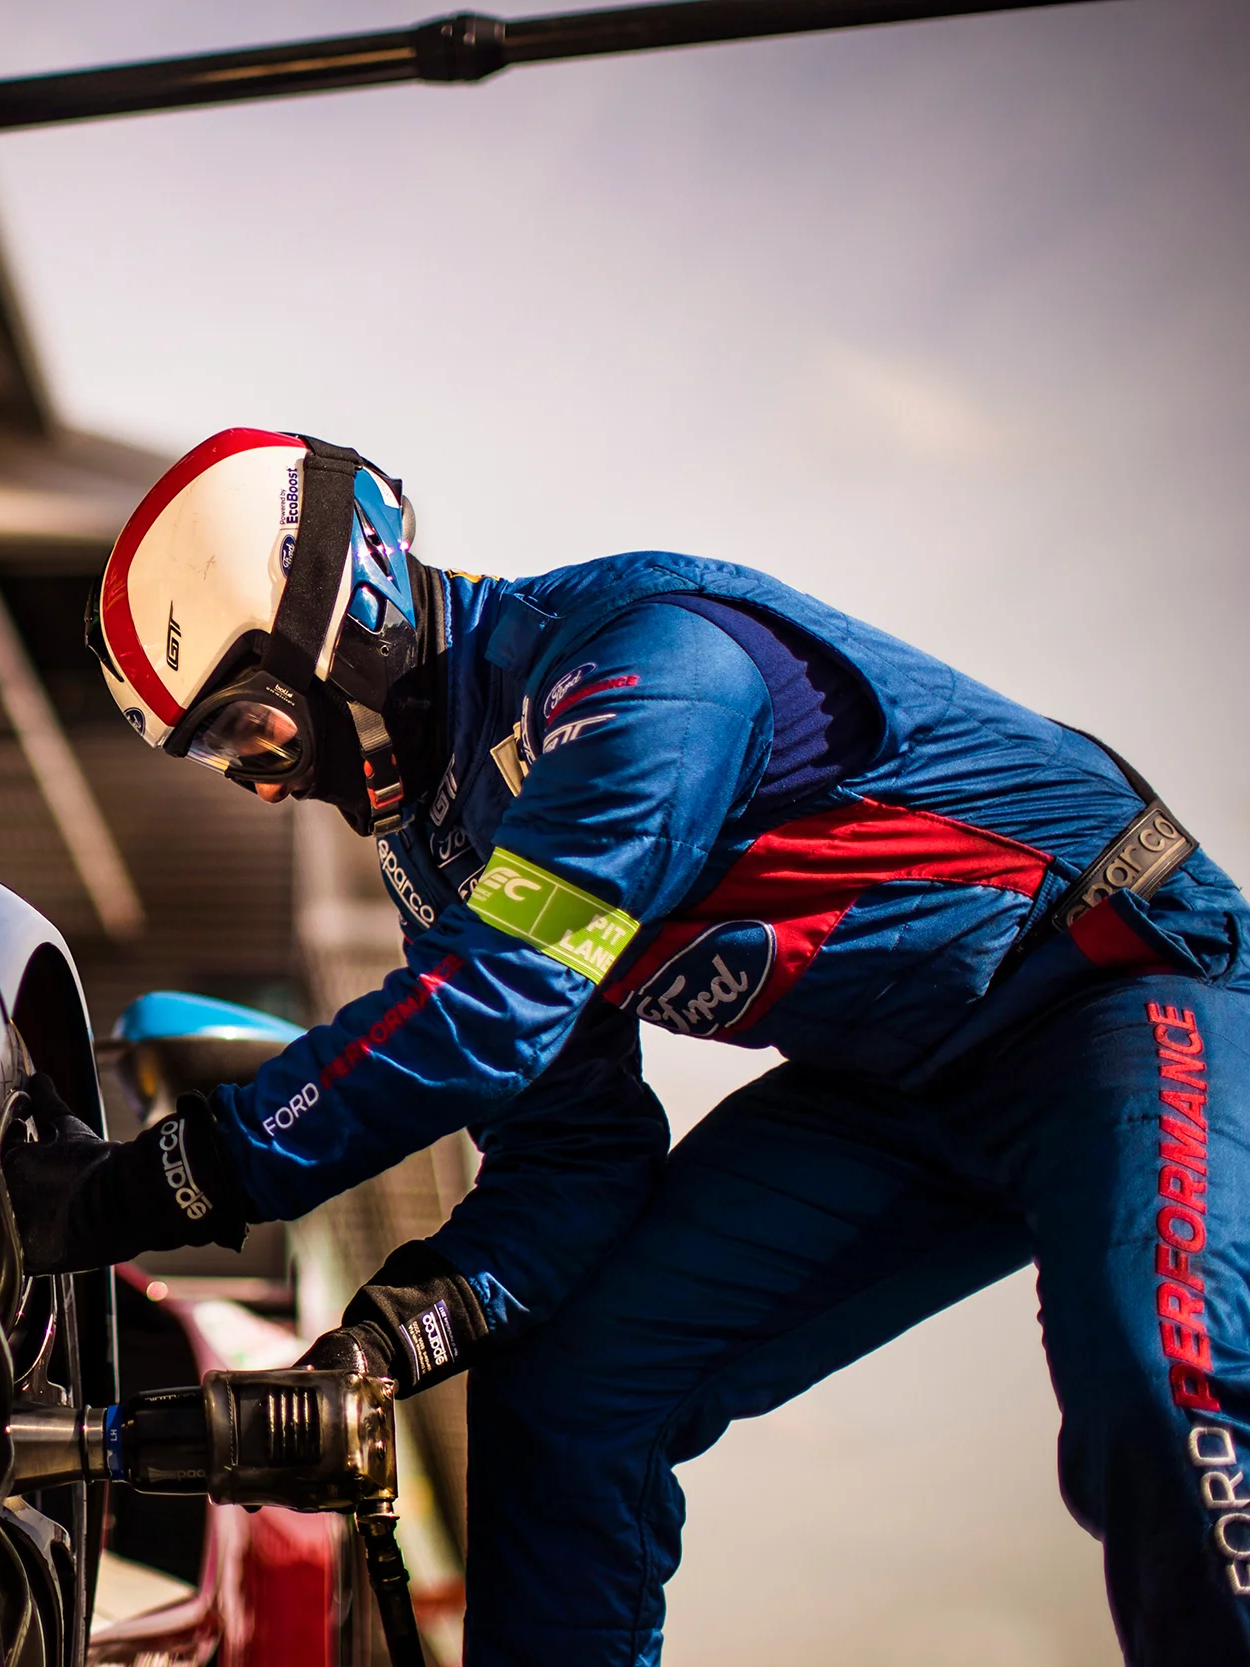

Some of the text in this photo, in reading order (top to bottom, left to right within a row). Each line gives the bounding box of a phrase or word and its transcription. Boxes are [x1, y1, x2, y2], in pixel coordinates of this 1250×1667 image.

[286, 467, 298, 524] EcoBoost
[283, 543, 295, 568] Ford
[166, 600, 181, 671] GT
[551, 670, 581, 709] Ford
[430, 753, 457, 826] GT
[378, 840, 434, 923] sparco
[558, 929, 615, 973] LANE
[586, 914, 626, 946] PIT
[636, 953, 748, 1033] Ford
[262, 1082, 320, 1136] FORD
[159, 1120, 207, 1220] sparco
[1145, 1002, 1220, 1410] PERFORMANCE
[422, 1314, 447, 1366] sparco
[110, 1429, 118, 1442] LH
